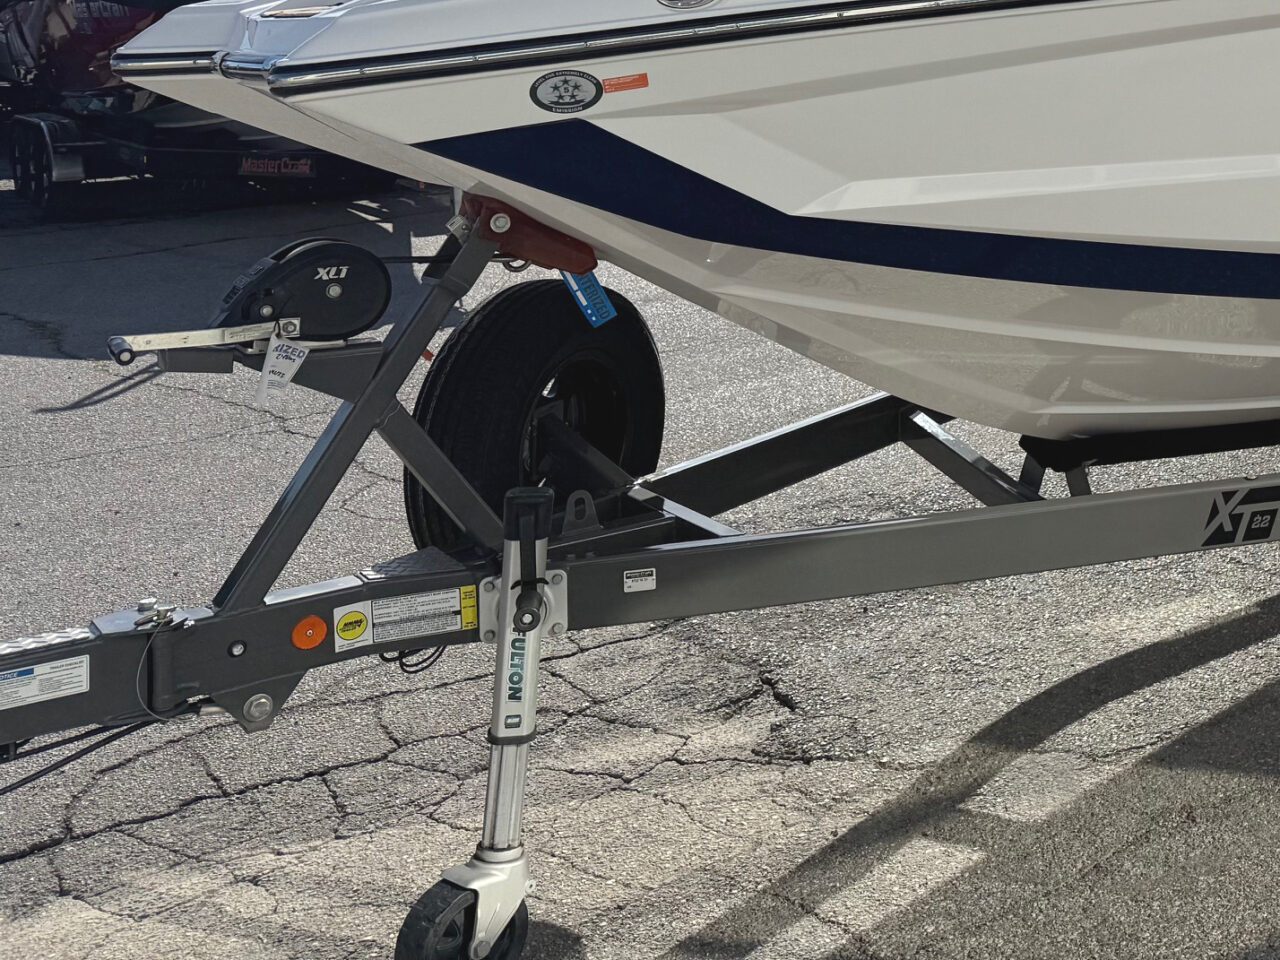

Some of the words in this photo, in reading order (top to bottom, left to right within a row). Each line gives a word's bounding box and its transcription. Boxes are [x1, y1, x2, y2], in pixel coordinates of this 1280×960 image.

[313, 266, 350, 280] XLT
[1251, 514, 1271, 529] 22
[507, 628, 527, 701] FULTON
